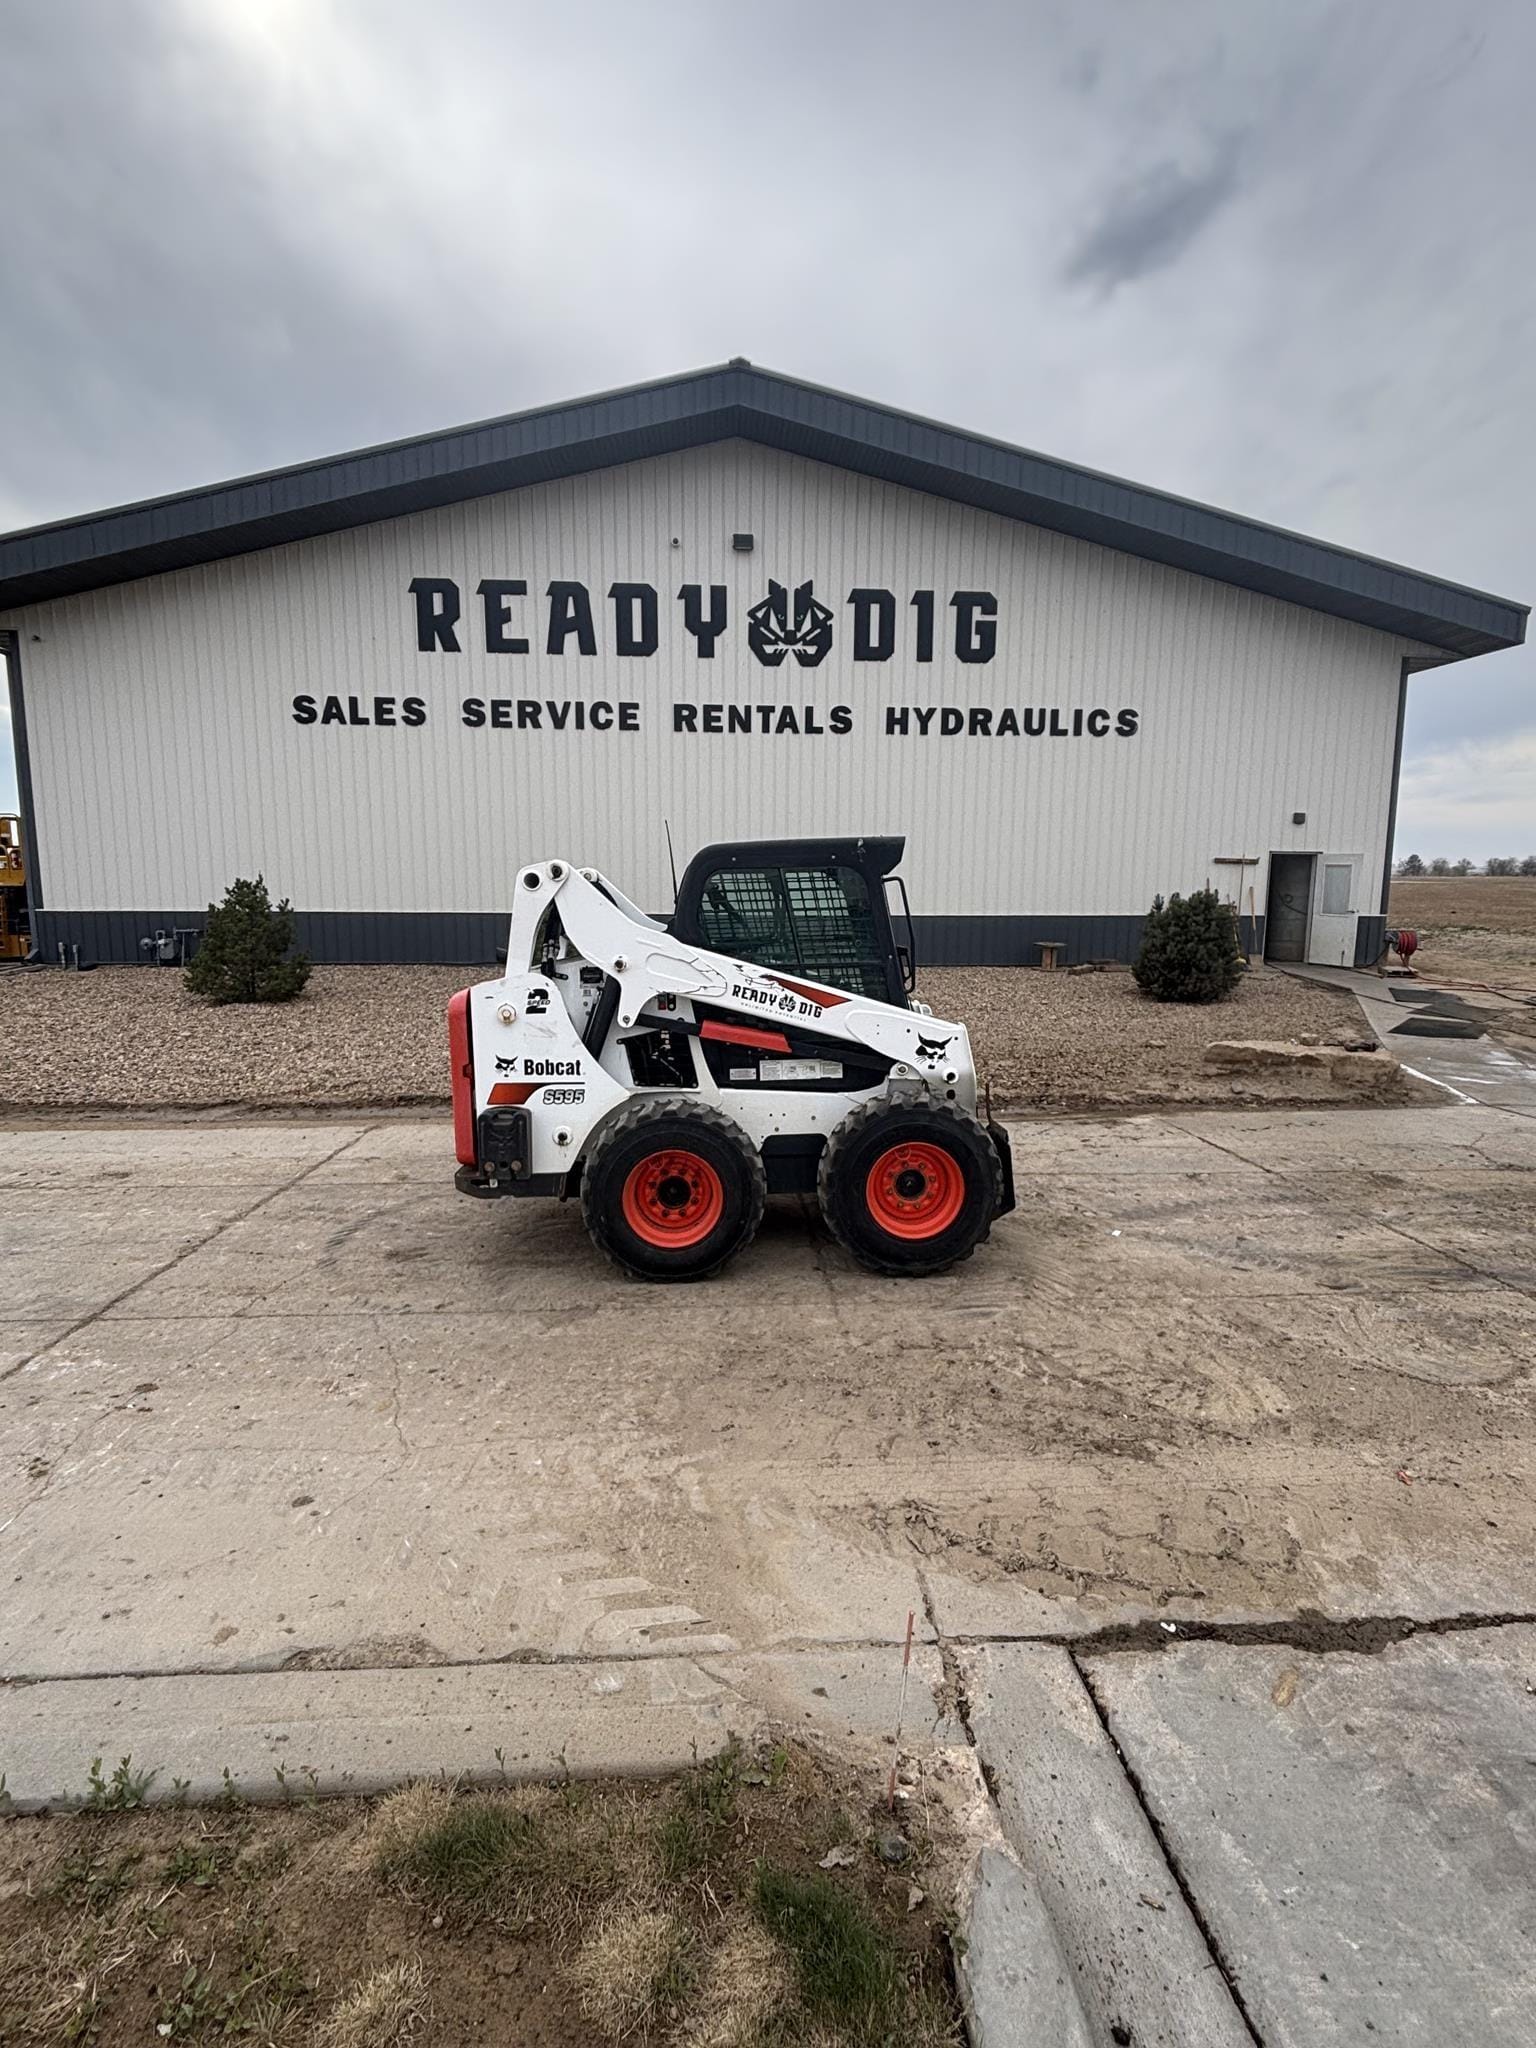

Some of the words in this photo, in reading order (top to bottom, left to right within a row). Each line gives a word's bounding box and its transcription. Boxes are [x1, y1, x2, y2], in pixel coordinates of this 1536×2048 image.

[408, 577, 727, 659] READY
[847, 588, 998, 664] DIG
[293, 694, 426, 727] SALES
[461, 698, 640, 732] SERVICE
[673, 703, 853, 735] RENTALS
[886, 706, 1139, 738] HYDRAULICS
[525, 988, 549, 1014] 2
[732, 984, 777, 1006] READY
[799, 1001, 823, 1018] DIG
[524, 1059, 581, 1076] Bobcat
[543, 1089, 585, 1105] S595
